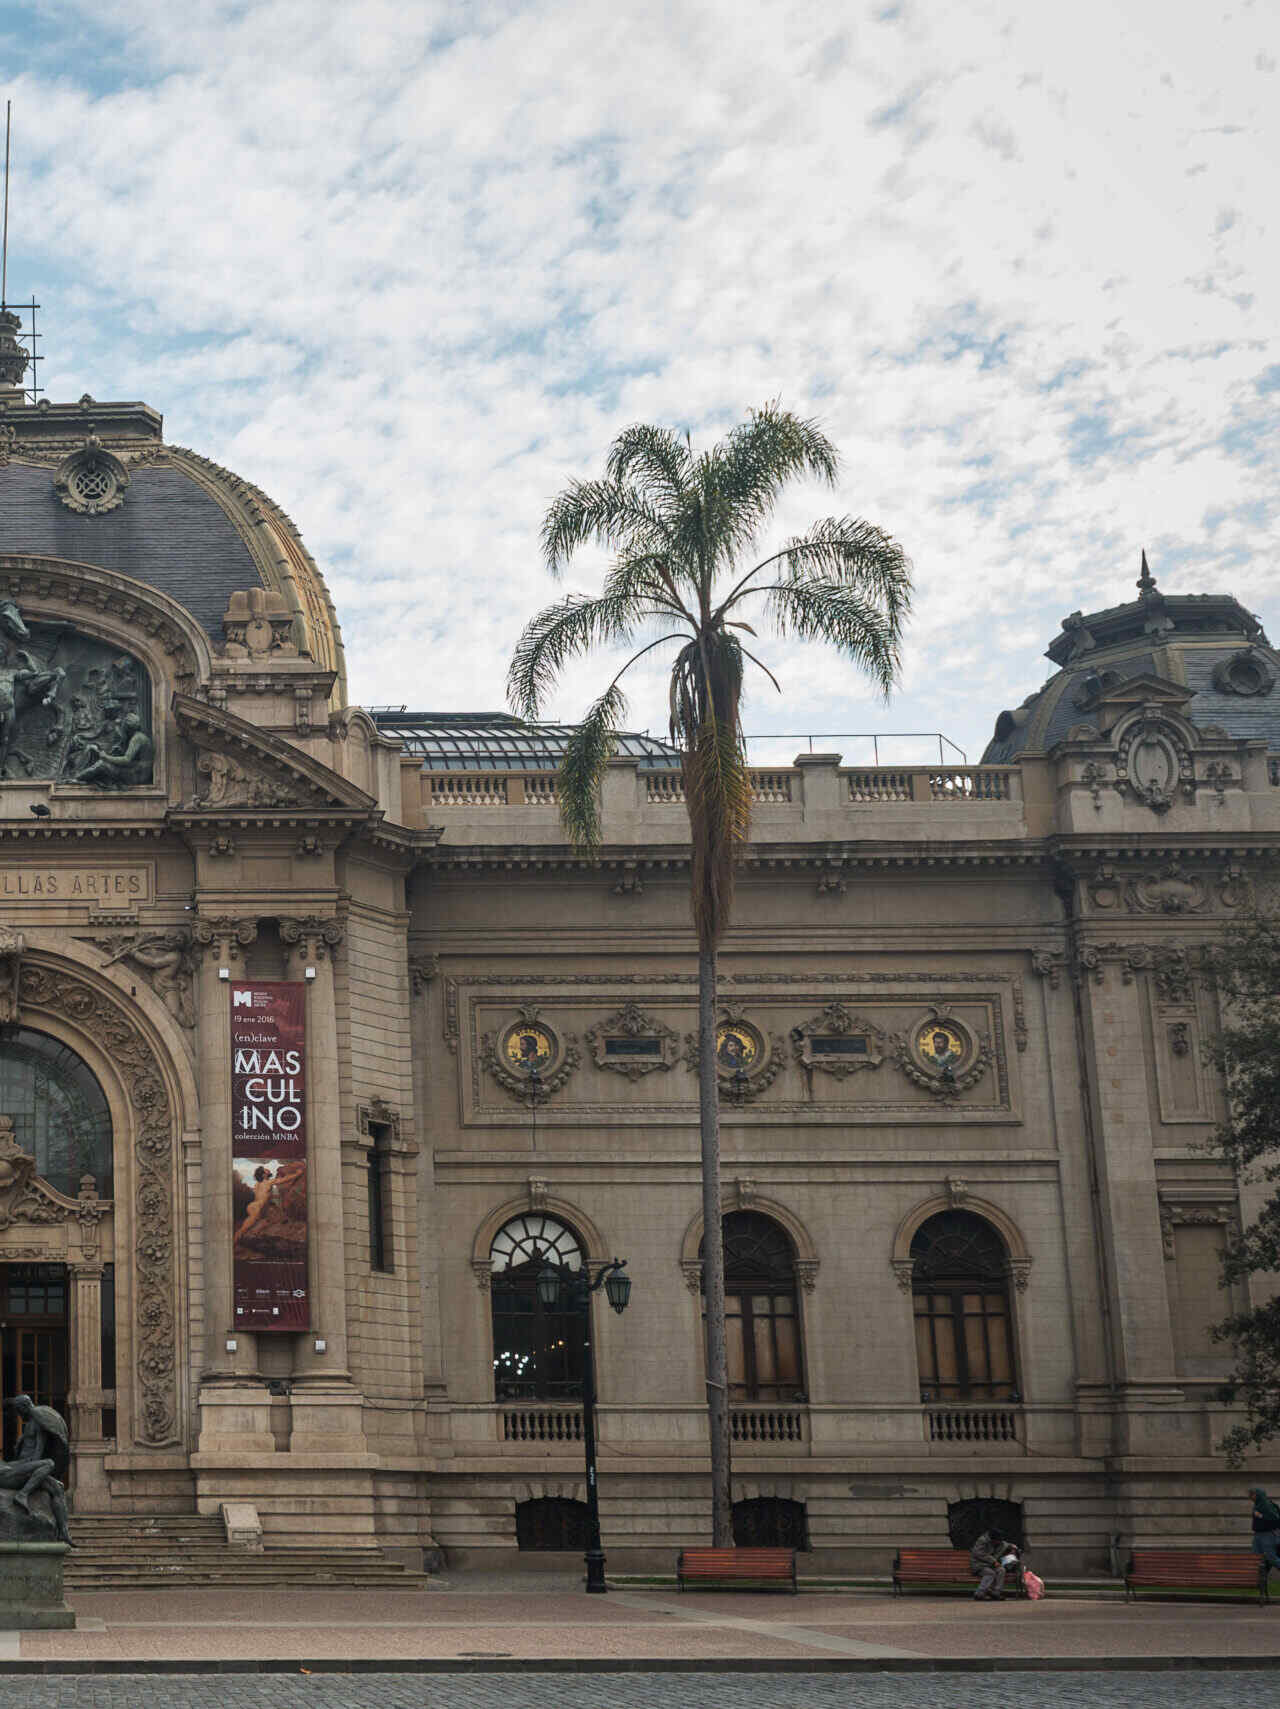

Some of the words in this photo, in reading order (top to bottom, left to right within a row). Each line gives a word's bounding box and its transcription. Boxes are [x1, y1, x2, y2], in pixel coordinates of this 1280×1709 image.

[71, 875, 141, 895] ARTES
[257, 1015, 275, 1023] 2016
[235, 1050, 301, 1075] MAS
[245, 1078, 301, 1102] CUL
[243, 1105, 301, 1131] INO
[273, 1132, 299, 1141] MNBA
